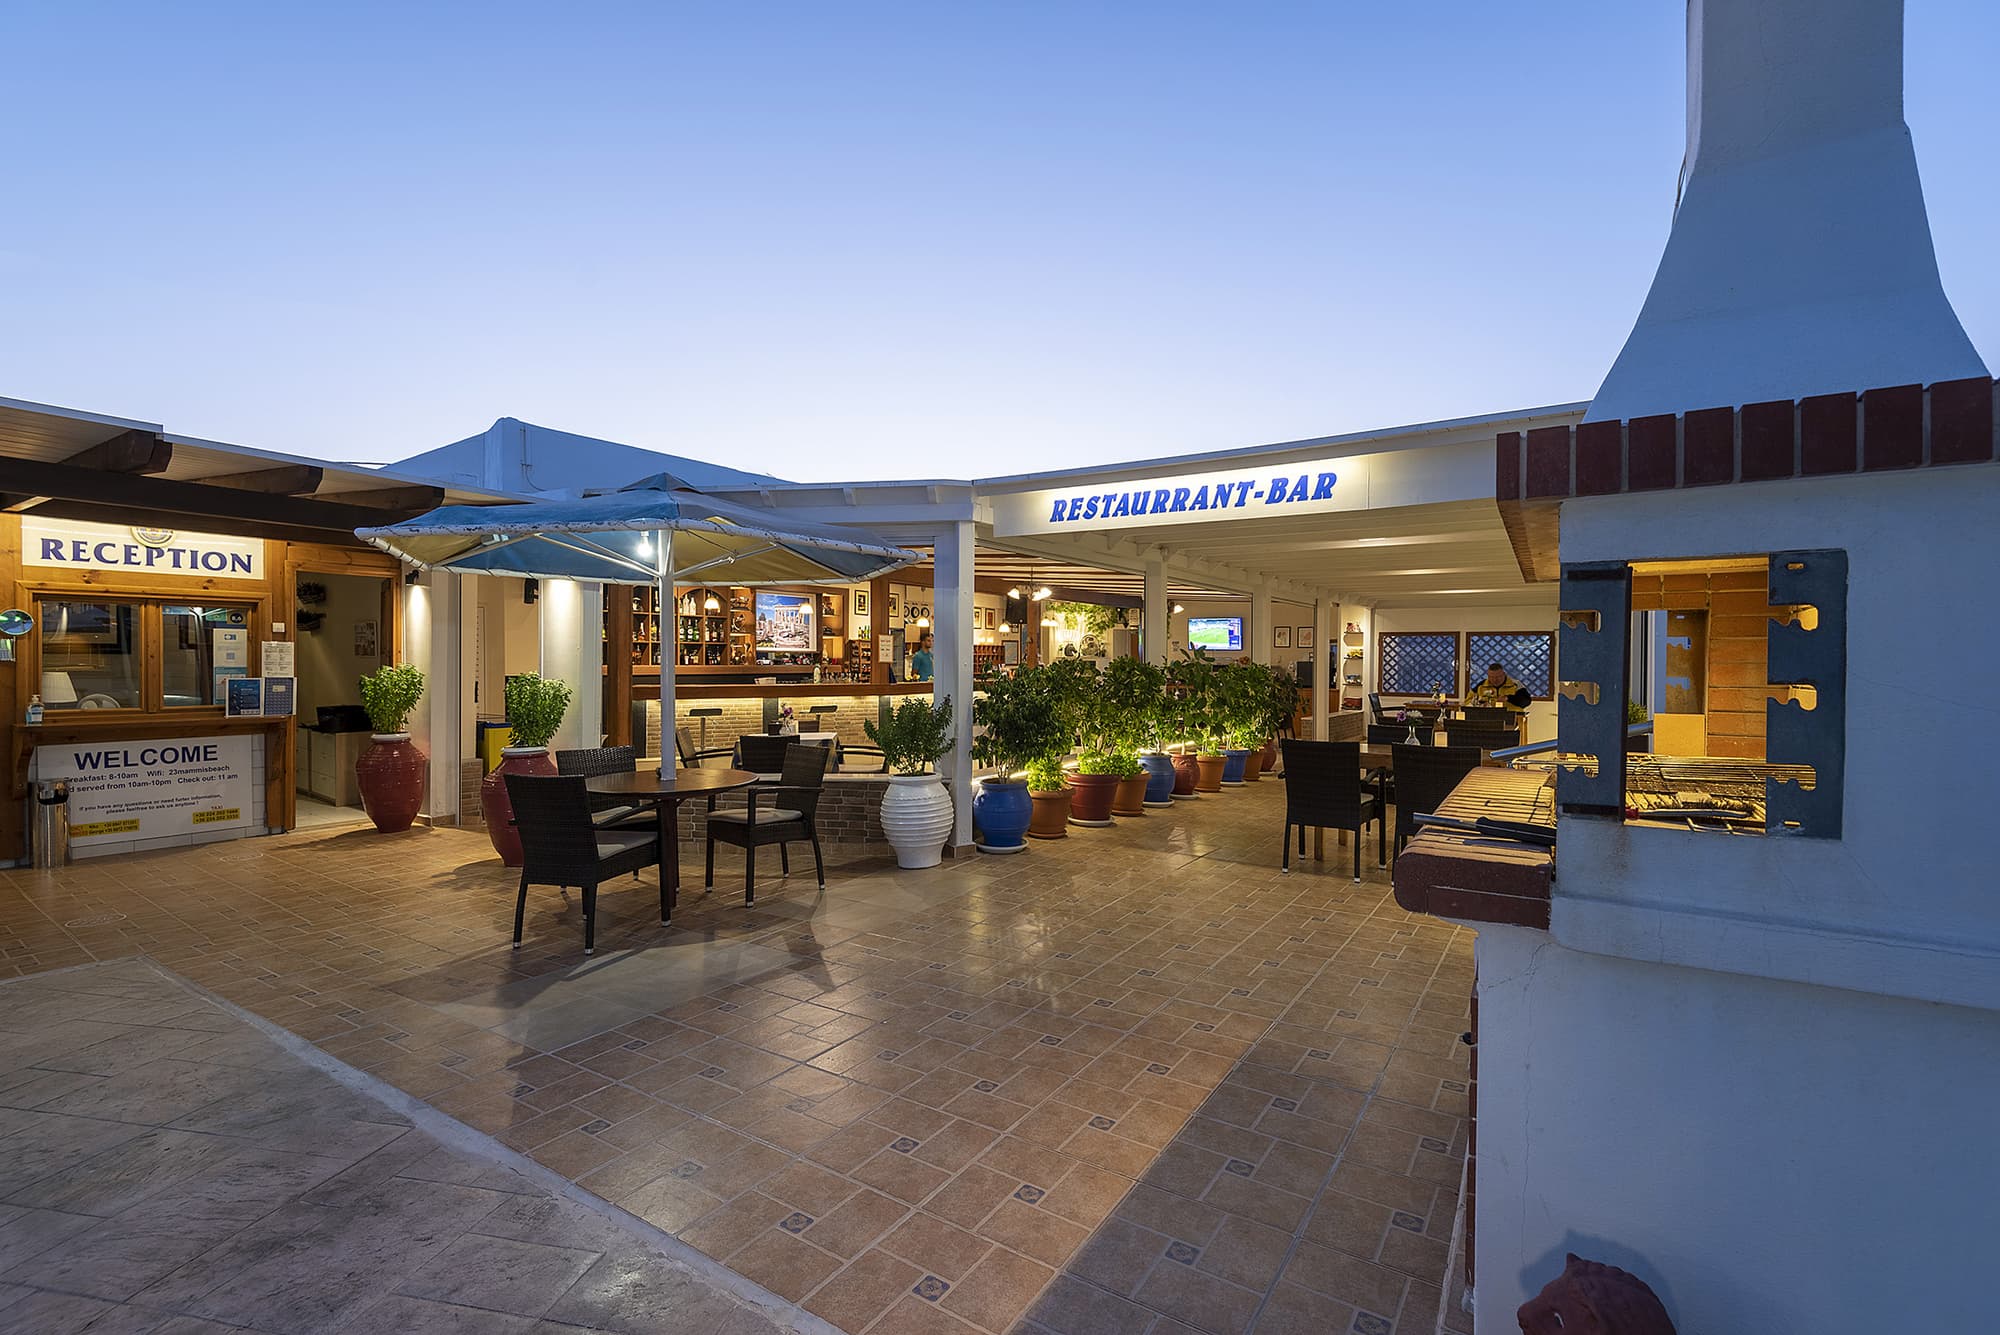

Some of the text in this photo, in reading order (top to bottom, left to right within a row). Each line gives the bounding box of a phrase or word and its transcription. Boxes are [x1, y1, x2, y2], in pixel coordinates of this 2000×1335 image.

[1049, 472, 1338, 523] RESTAURRANT-BAR
[40, 537, 253, 574] RECEPTION
[74, 744, 218, 770] WELCOME
[76, 783, 105, 792] served
[107, 781, 126, 790] from
[128, 778, 172, 788] 10am-10pm
